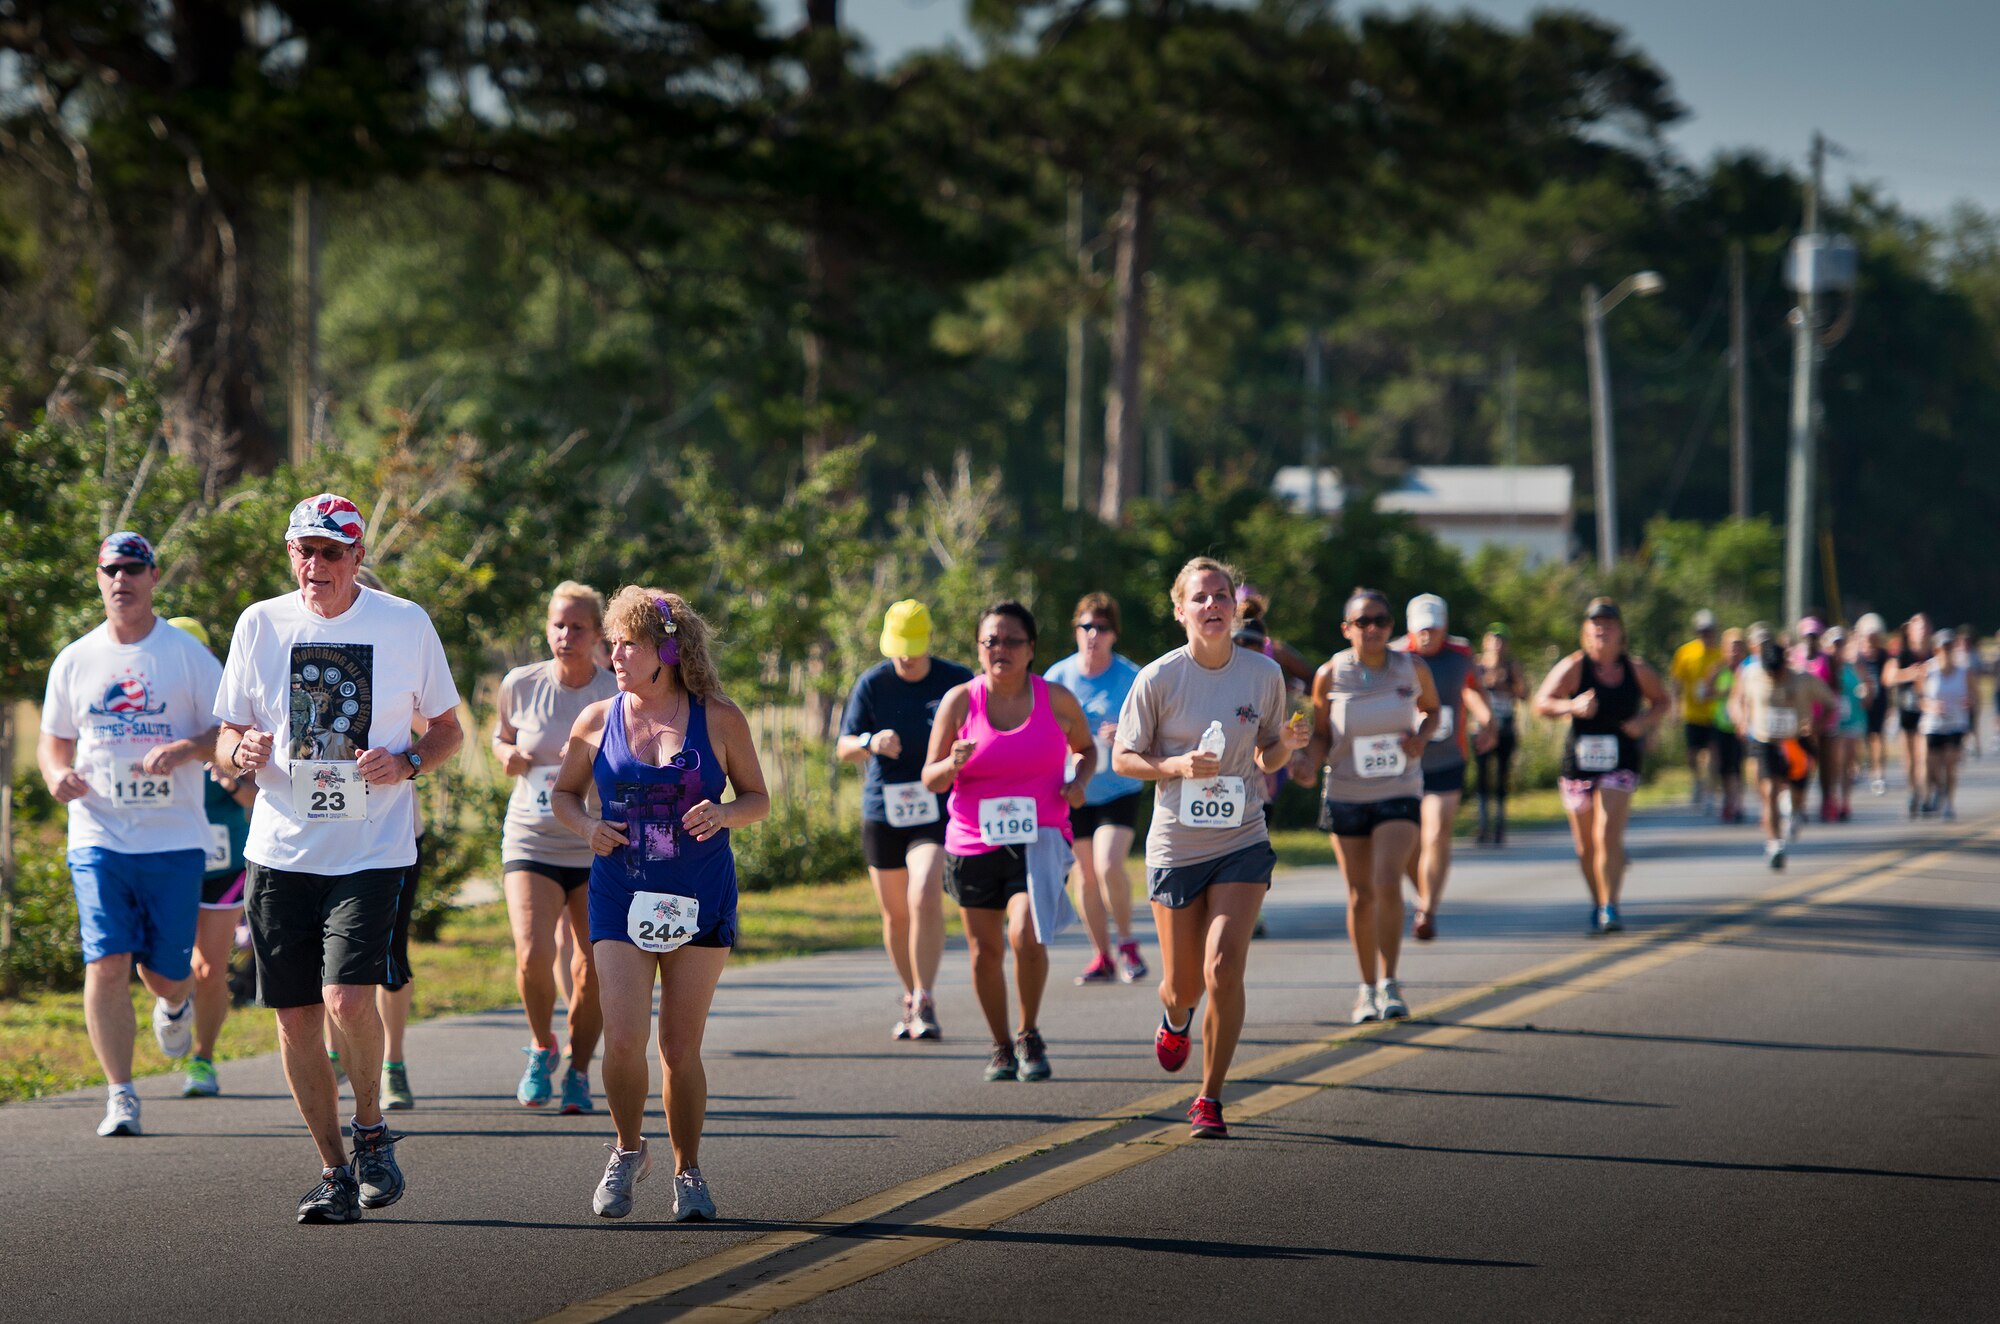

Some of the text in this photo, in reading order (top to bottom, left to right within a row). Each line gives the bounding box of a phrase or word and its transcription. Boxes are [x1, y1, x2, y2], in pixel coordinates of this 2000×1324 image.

[293, 648, 348, 667] HONORING
[344, 661, 361, 679] ALL
[355, 677, 371, 701] WHO
[350, 703, 371, 735] SERVE
[132, 722, 173, 736] SALUTE
[115, 781, 169, 797] 1124
[536, 790, 552, 806] 4
[311, 791, 346, 811] 23
[895, 802, 928, 818] 372
[1191, 800, 1235, 818] 609
[985, 818, 1033, 836] 1196
[639, 920, 687, 942] 244
